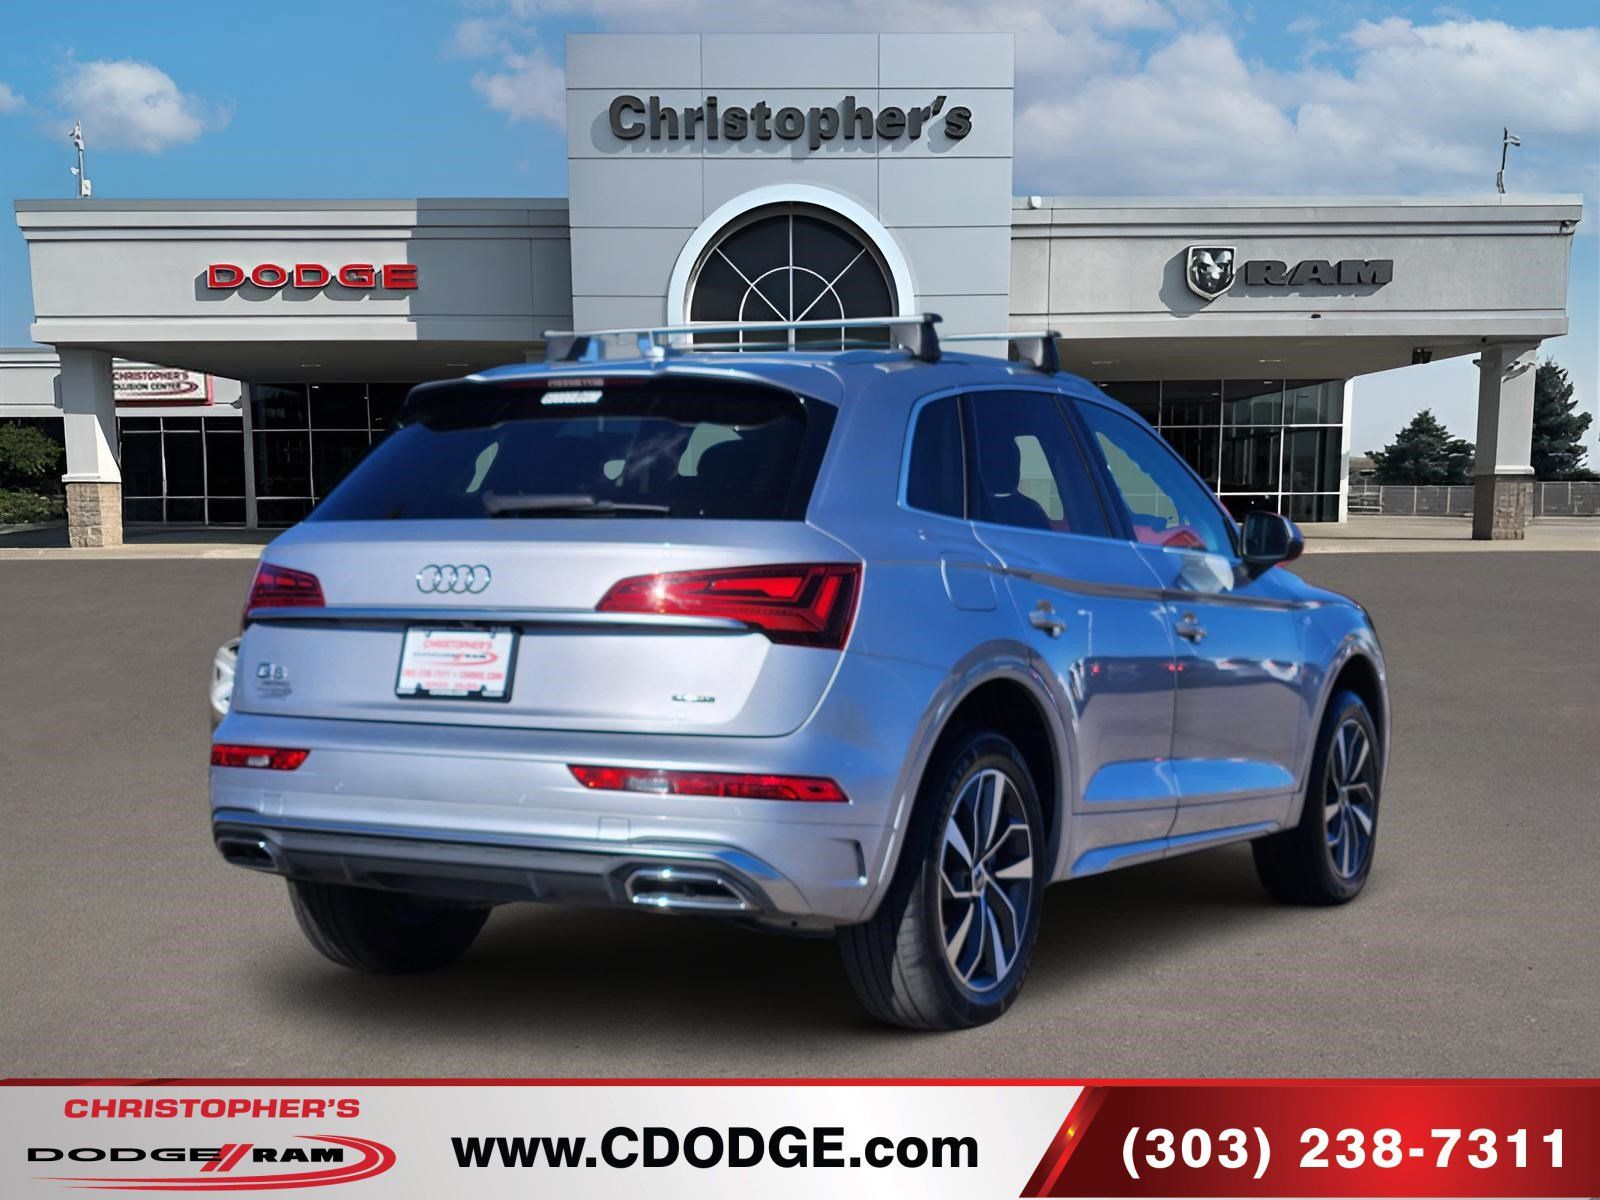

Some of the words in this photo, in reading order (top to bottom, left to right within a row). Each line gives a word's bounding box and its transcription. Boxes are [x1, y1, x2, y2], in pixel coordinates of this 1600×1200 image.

[608, 94, 972, 150] Christopher's
[206, 263, 418, 289] DODGE
[1245, 259, 1393, 286] RAM
